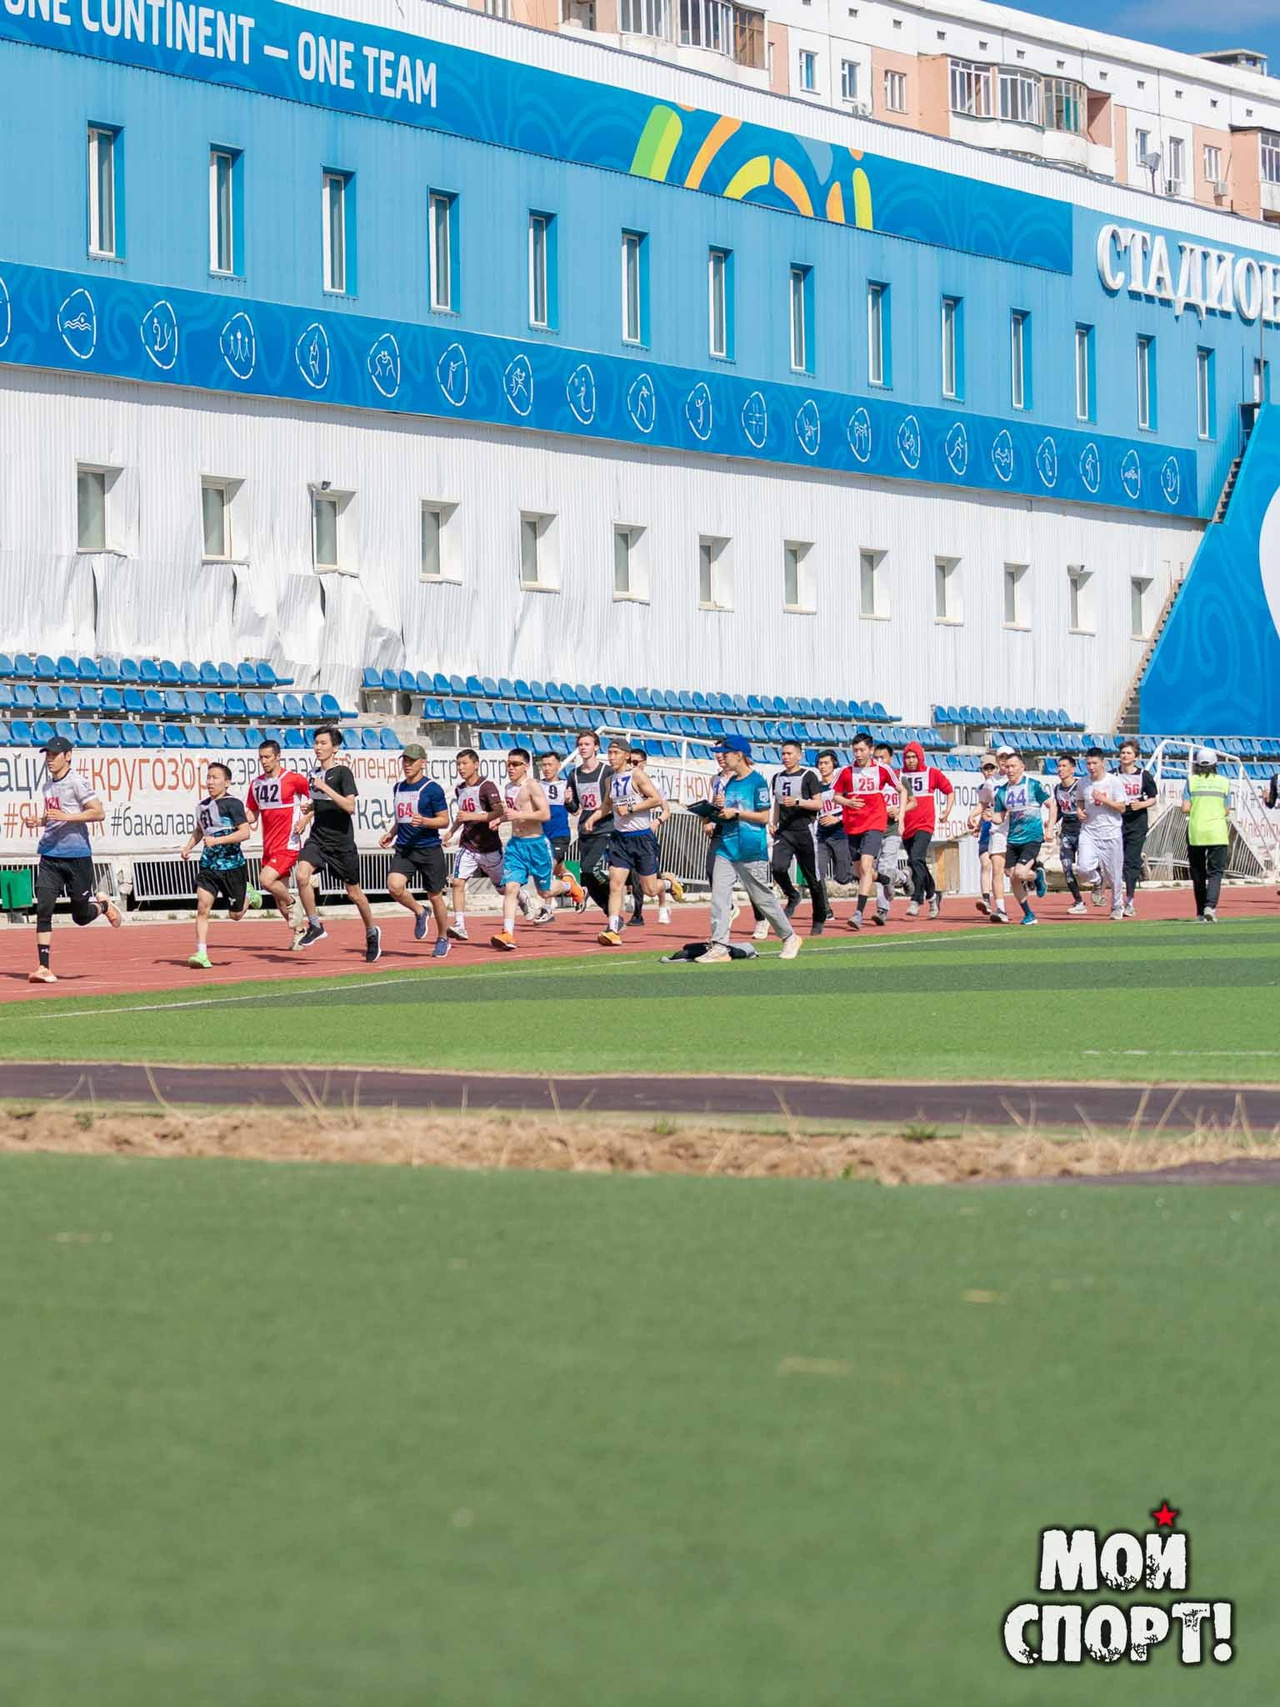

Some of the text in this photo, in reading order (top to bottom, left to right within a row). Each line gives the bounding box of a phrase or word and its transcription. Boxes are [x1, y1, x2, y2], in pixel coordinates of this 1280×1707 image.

[81, 0, 255, 65] CONTINENT
[298, 31, 355, 89] ONE
[362, 45, 437, 108] TEAM
[858, 777, 874, 792] 25
[1124, 783, 1140, 797] 56
[254, 784, 279, 803] 142
[581, 793, 597, 808] 23
[1006, 788, 1027, 807] 44
[397, 802, 413, 819] 64
[461, 797, 476, 813] 46
